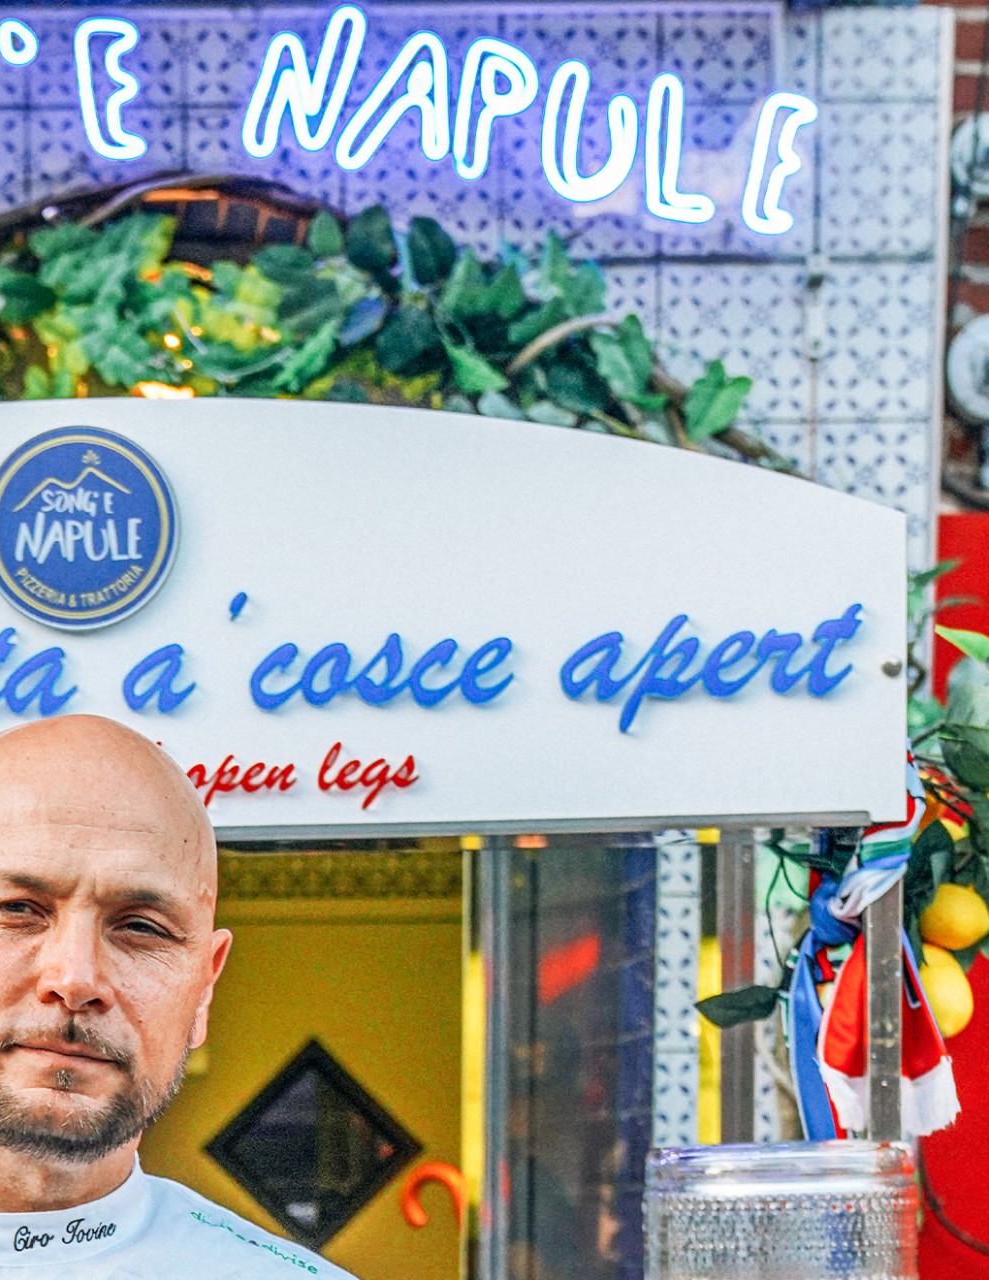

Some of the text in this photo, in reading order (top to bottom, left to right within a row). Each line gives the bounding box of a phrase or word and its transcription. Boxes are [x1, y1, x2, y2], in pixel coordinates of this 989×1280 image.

[241, 4, 818, 235] NAPULE
[13, 511, 144, 565] NAPULE
[15, 564, 145, 608] PIZZERIA & TRATTORIA
[560, 603, 865, 733] apert
[318, 741, 420, 810] legs
[13, 1225, 54, 1252] Ciro
